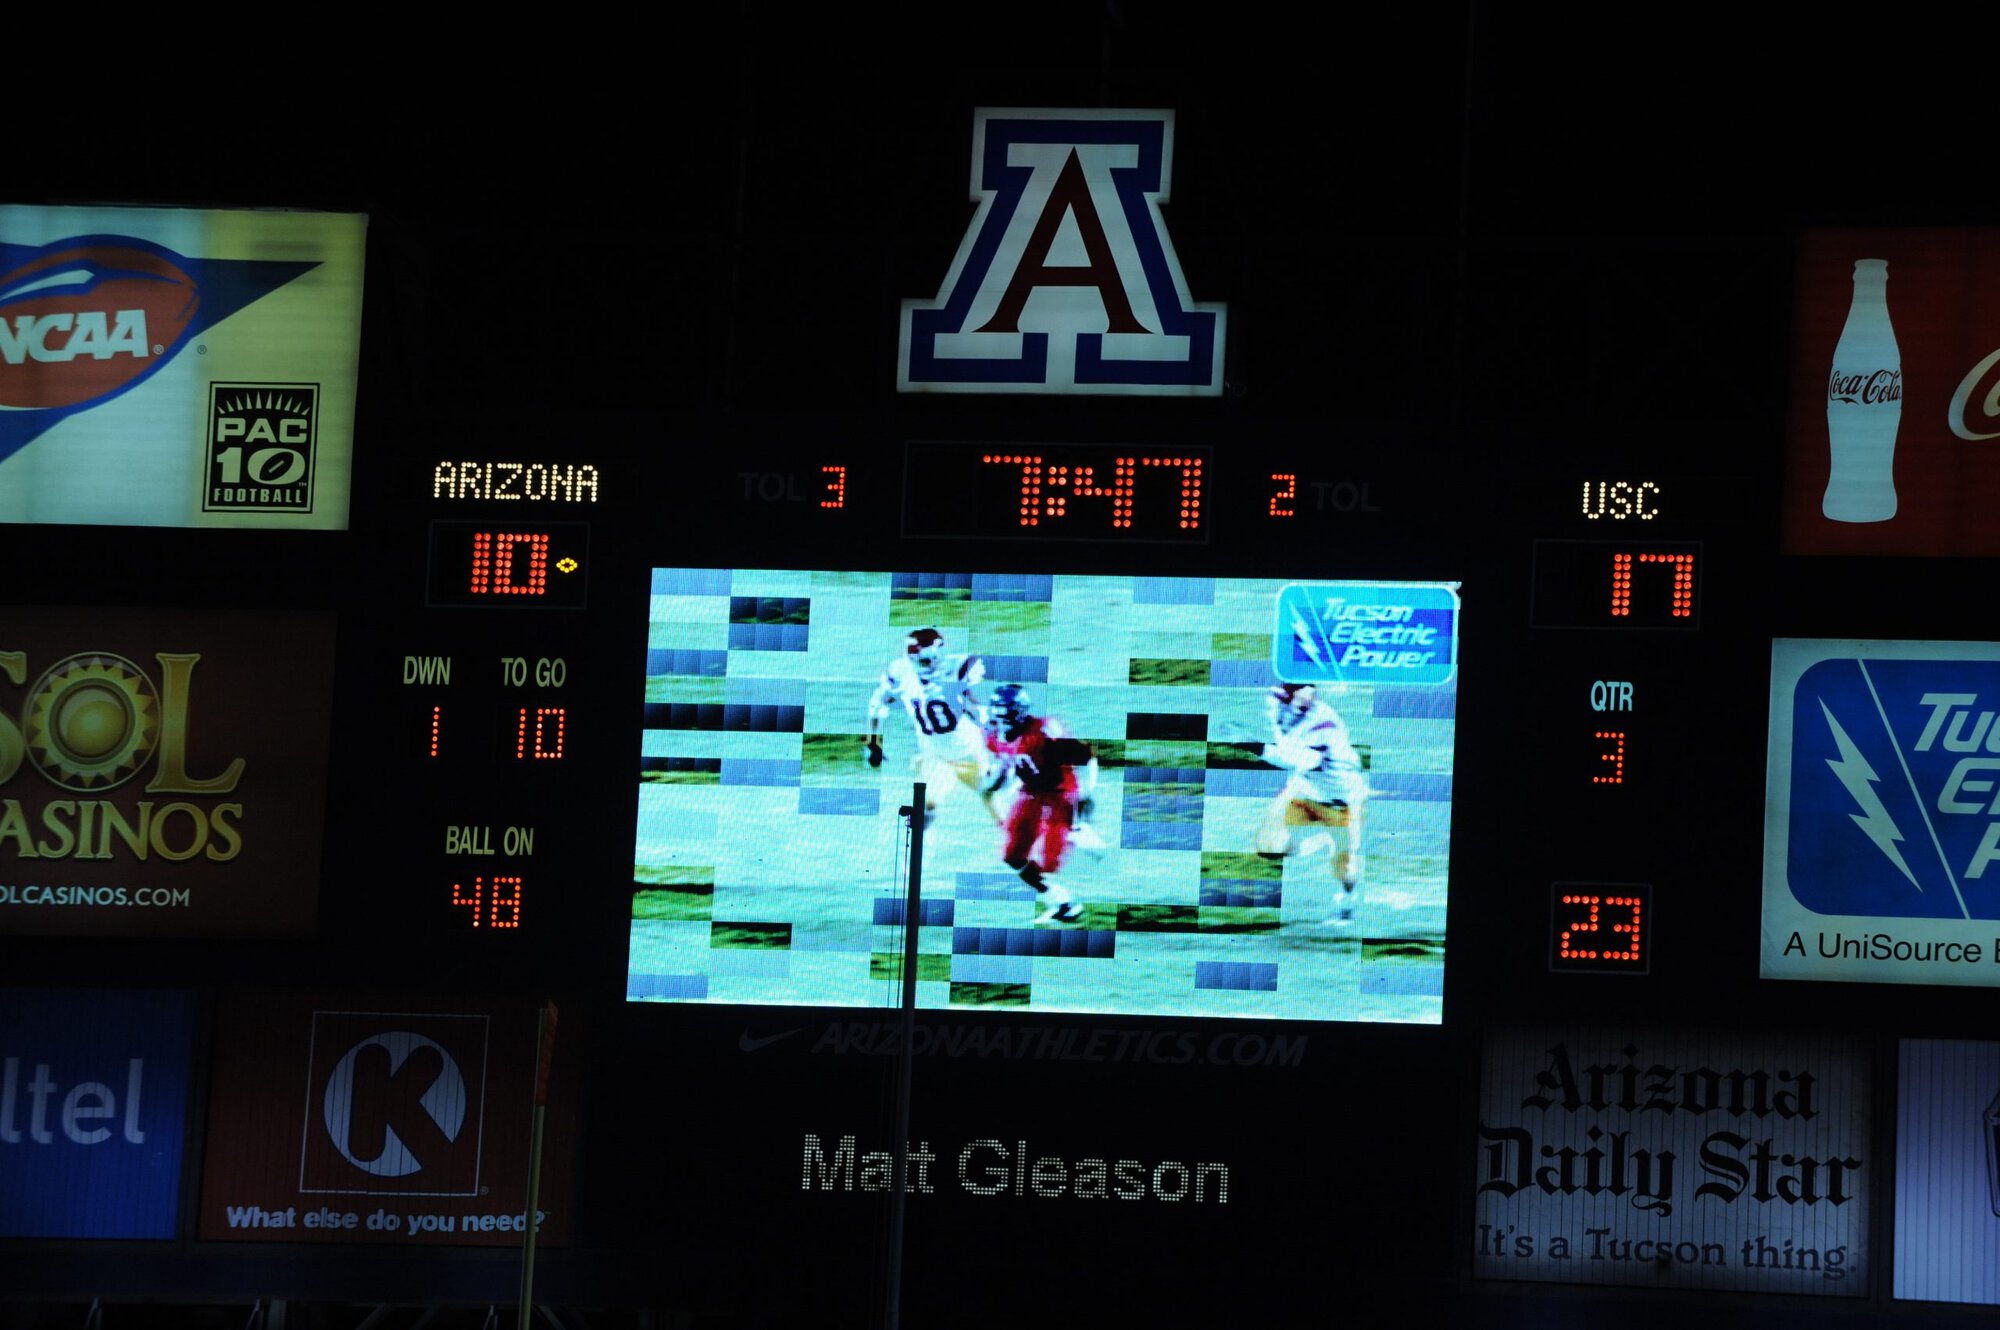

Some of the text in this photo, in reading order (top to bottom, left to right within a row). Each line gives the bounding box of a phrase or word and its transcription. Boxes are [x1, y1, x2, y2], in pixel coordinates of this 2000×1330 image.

[896, 107, 1229, 397] A
[0, 309, 149, 364] NCAA
[1830, 369, 1901, 404] Coca-Cola
[216, 417, 308, 444] PAC
[216, 446, 306, 486] 10
[434, 460, 599, 502] ARIZONA
[738, 465, 847, 508] TOL 3
[213, 487, 302, 504] FOOTBALL
[982, 455, 1202, 529] 7:47
[1268, 473, 1381, 517] 2 TOL
[1582, 480, 1661, 520] USC
[470, 532, 549, 595] 10
[1611, 553, 1694, 617] 17
[1322, 597, 1414, 623] Tucson
[1329, 622, 1438, 646] Electric
[403, 656, 451, 686] DWN
[501, 656, 567, 688] TO GO
[1340, 645, 1438, 668] Power
[913, 699, 957, 735] 10
[1590, 680, 1633, 711] QTR
[430, 706, 441, 758] 1
[516, 707, 566, 759] 10
[1592, 731, 1626, 784] 3
[445, 825, 534, 856] BALL ON
[452, 875, 522, 928] 48
[1561, 895, 1641, 960] 23
[1783, 931, 1807, 957] A
[1818, 932, 1983, 963] UniSource
[810, 1021, 1309, 1068] ARIZONAATHLETICS.COM
[1521, 1041, 1820, 1120] Arizona
[801, 1133, 1232, 1204] Matt Gleason
[1477, 1121, 1863, 1217] Daily Star
[226, 1206, 545, 1236] What else do you need?
[1478, 1224, 1857, 1281] It's a Tucson thing.
